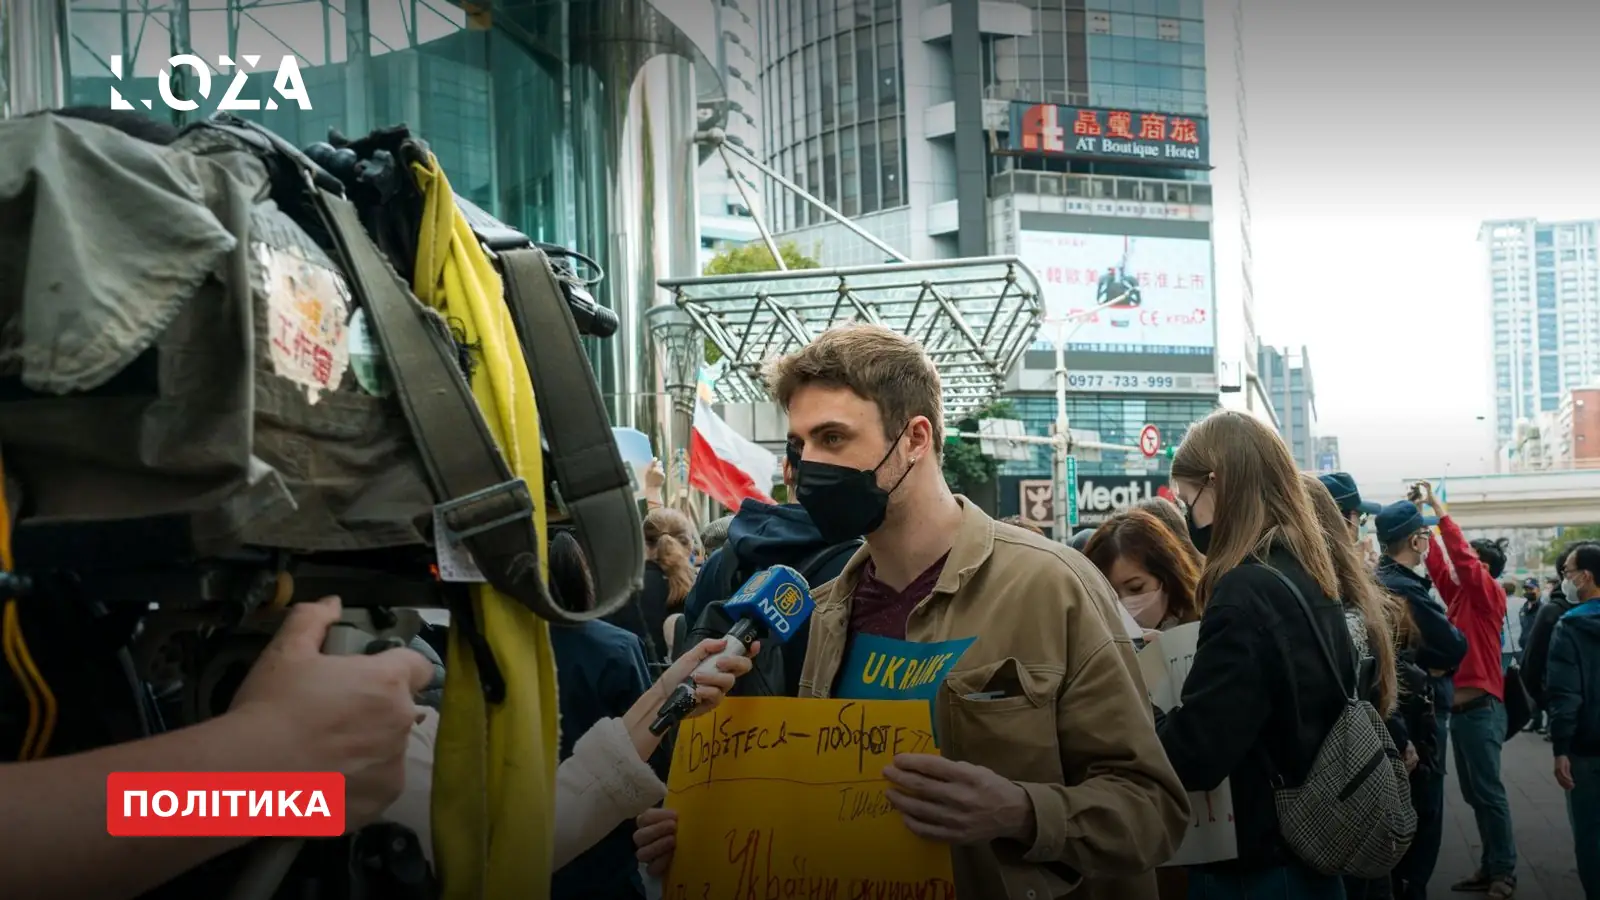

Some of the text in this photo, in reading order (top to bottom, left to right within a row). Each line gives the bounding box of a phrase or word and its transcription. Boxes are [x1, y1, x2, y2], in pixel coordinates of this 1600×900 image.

[1075, 137, 1200, 160] AT Boutique Hotel
[1077, 480, 1141, 510] Meat
[757, 597, 790, 634] NTD
[862, 651, 954, 690] UKRAINE
